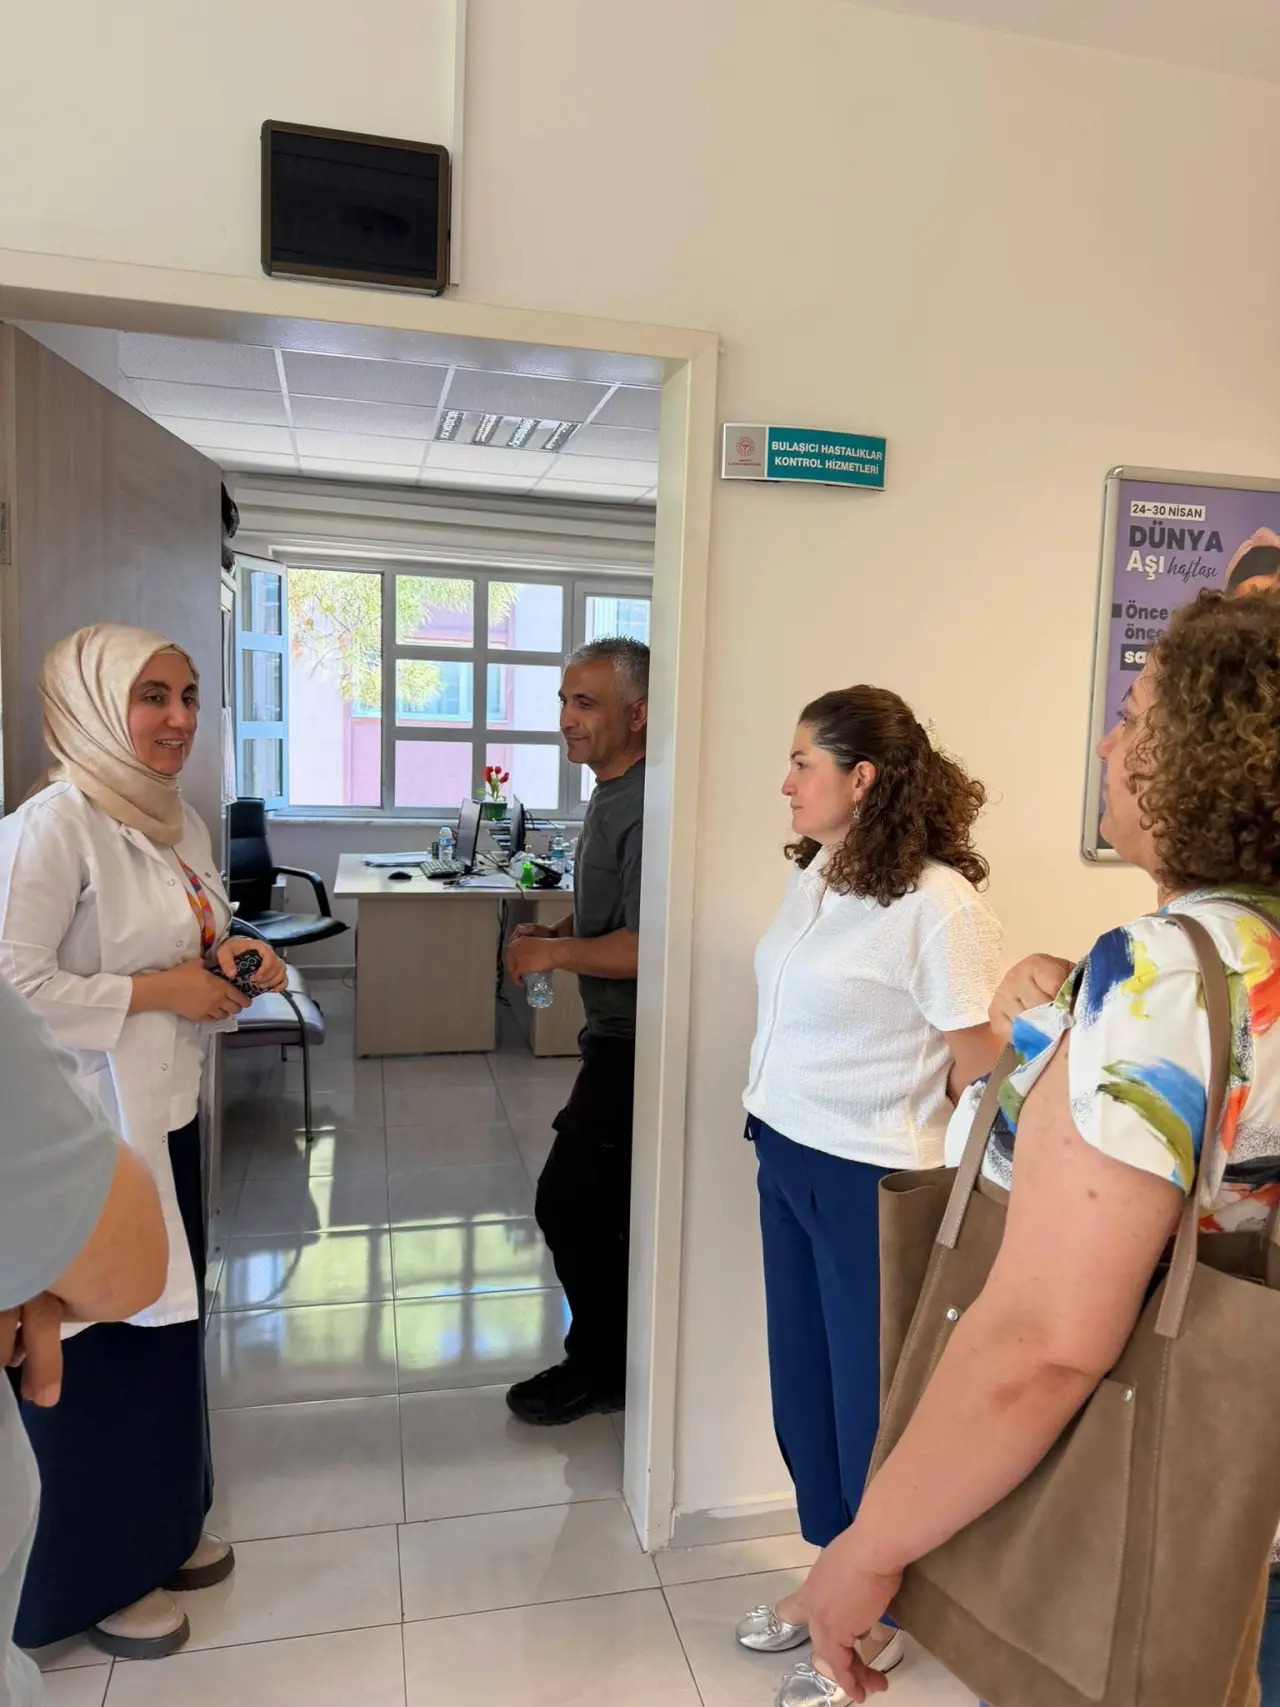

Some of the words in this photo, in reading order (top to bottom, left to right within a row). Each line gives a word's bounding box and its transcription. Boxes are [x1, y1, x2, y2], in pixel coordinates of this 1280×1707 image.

[772, 441, 819, 454] BULAŞICI
[821, 445, 883, 461] HASTALIKLAR
[775, 456, 823, 469] KONTROL
[825, 460, 879, 475] HİZMETLERİ
[1132, 503, 1166, 516] 24-30
[1168, 504, 1202, 518] NİSAN
[1129, 520, 1224, 553] DÜNYA
[1126, 550, 1165, 581] AŞI
[1125, 600, 1168, 620] Önce
